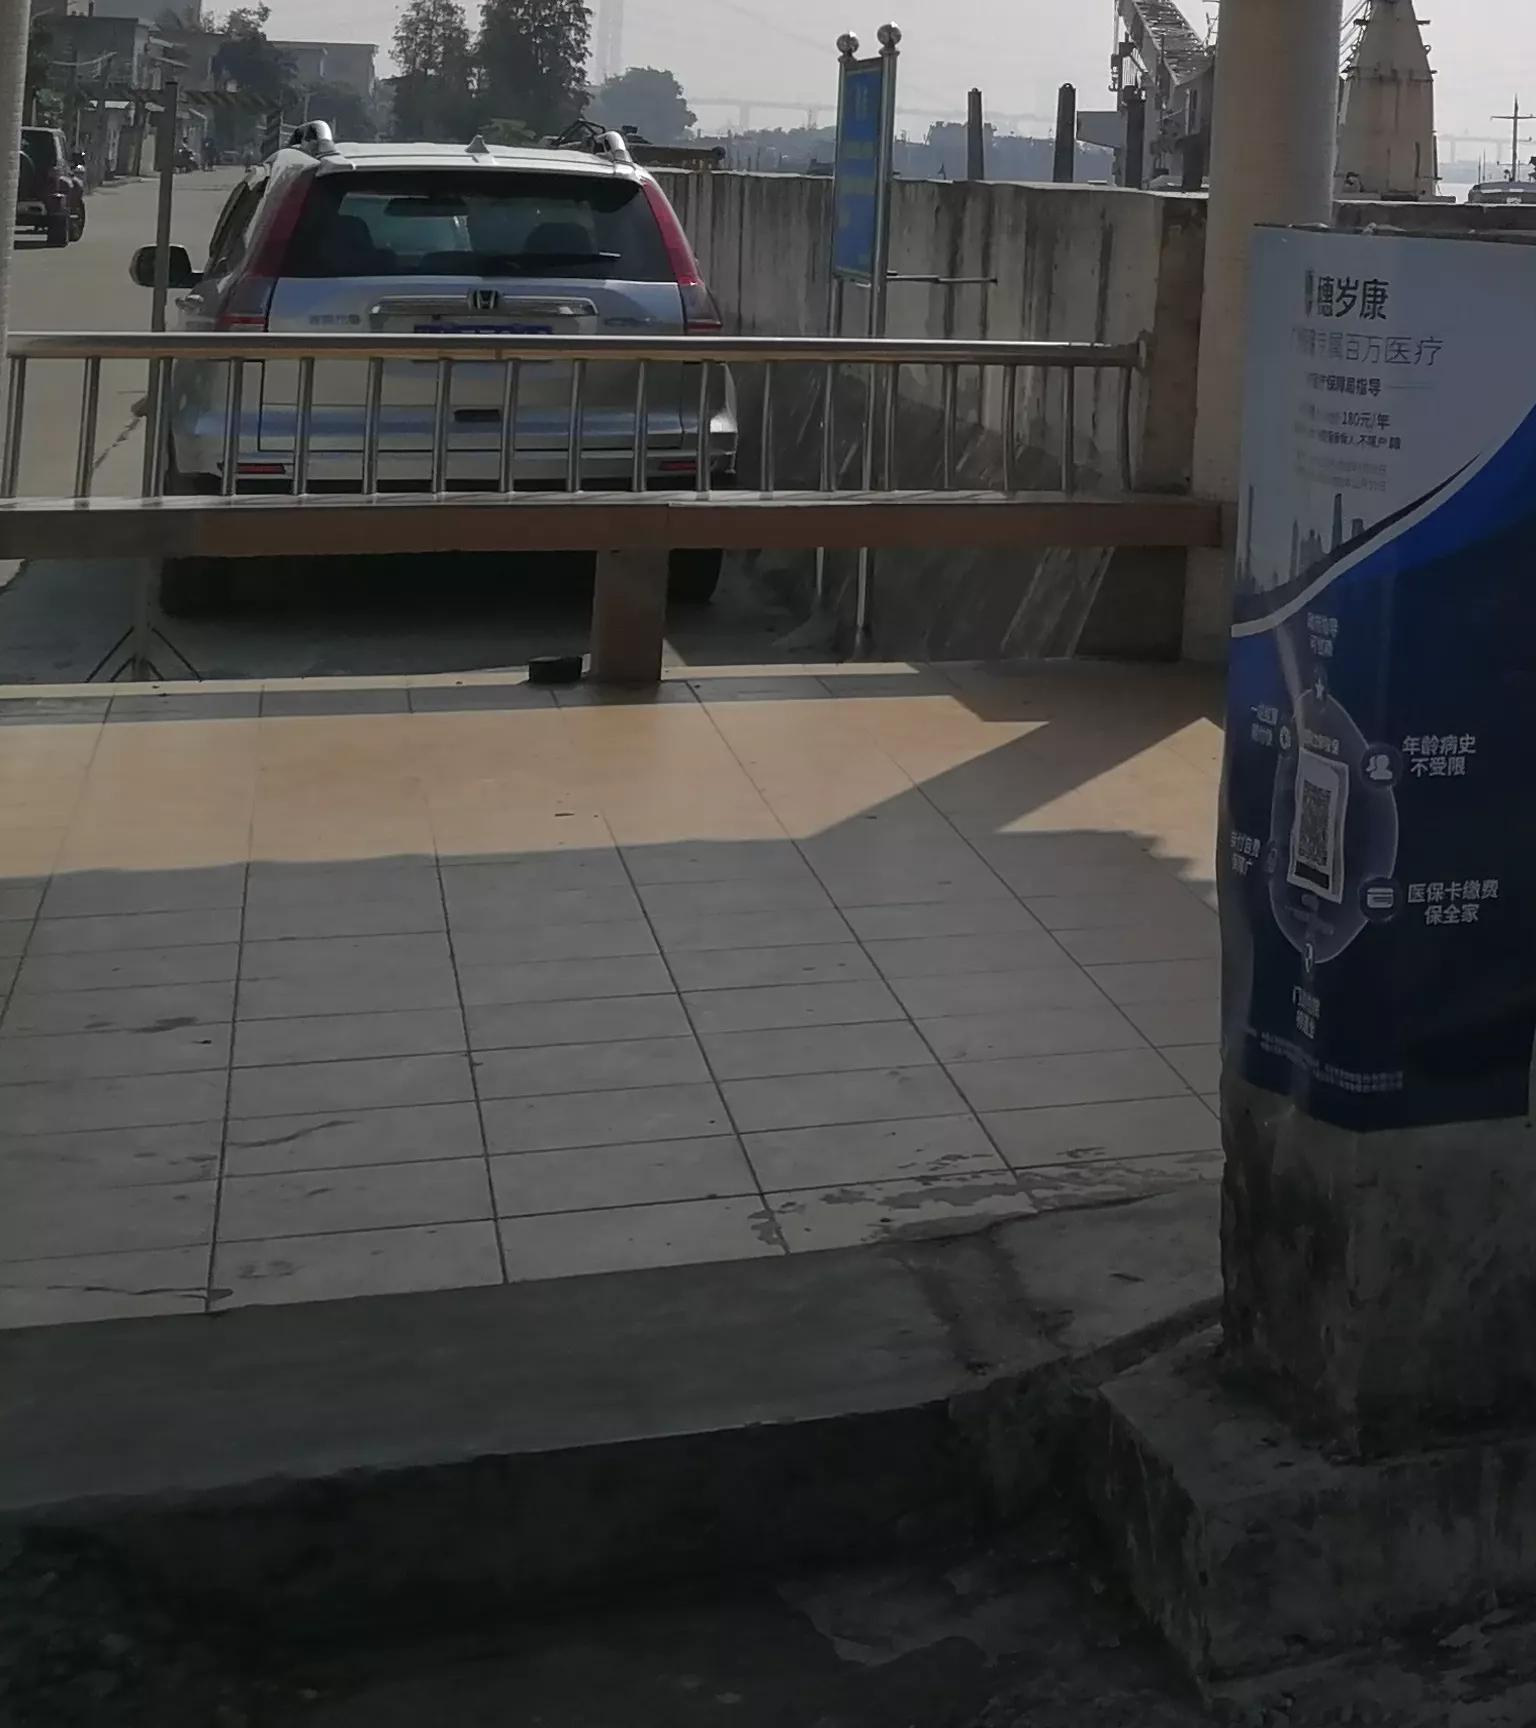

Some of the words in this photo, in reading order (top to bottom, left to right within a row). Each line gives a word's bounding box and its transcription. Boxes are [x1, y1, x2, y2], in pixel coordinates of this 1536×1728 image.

[1402, 733, 1477, 756] 年龄病史
[1410, 756, 1467, 778] 不受限
[1407, 879, 1500, 904] 医保卡缴费
[1424, 903, 1480, 926] 保全家
